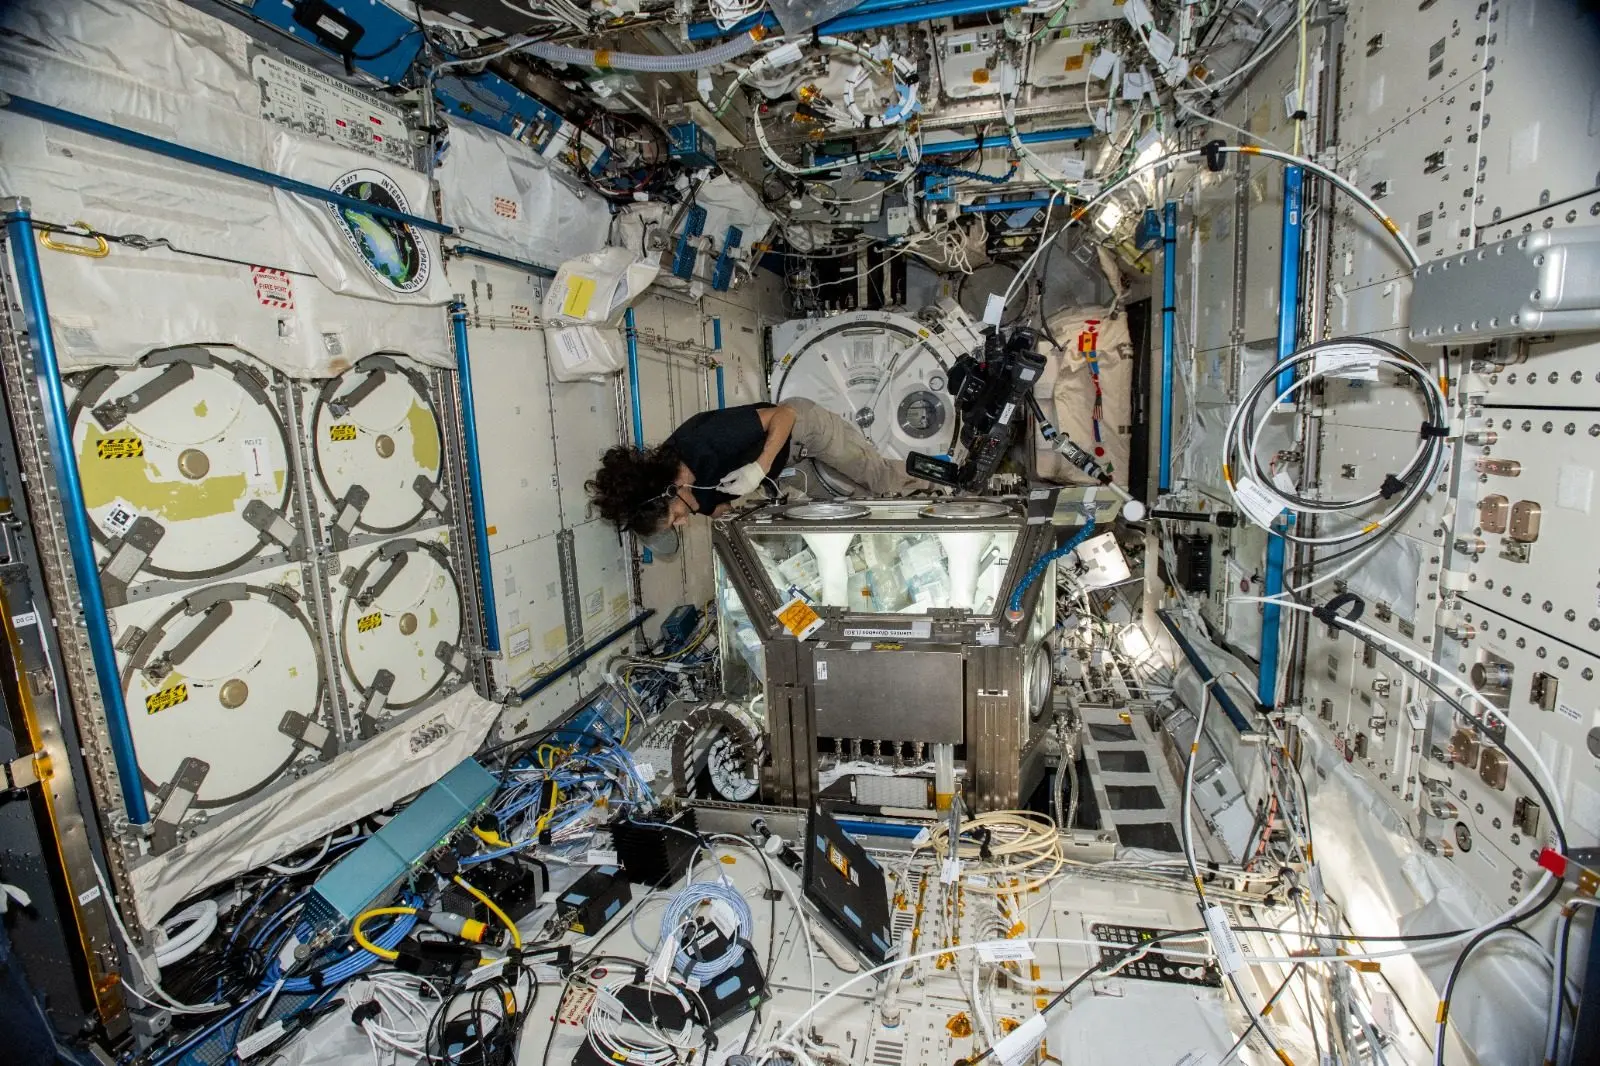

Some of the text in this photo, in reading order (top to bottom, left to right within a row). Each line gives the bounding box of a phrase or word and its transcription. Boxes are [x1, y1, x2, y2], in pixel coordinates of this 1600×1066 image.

[284, 56, 306, 73] MINUS
[307, 67, 330, 83] EIGHTY
[331, 79, 344, 91] LAB
[344, 86, 370, 102] FREEZER
[418, 247, 429, 272] SPACE
